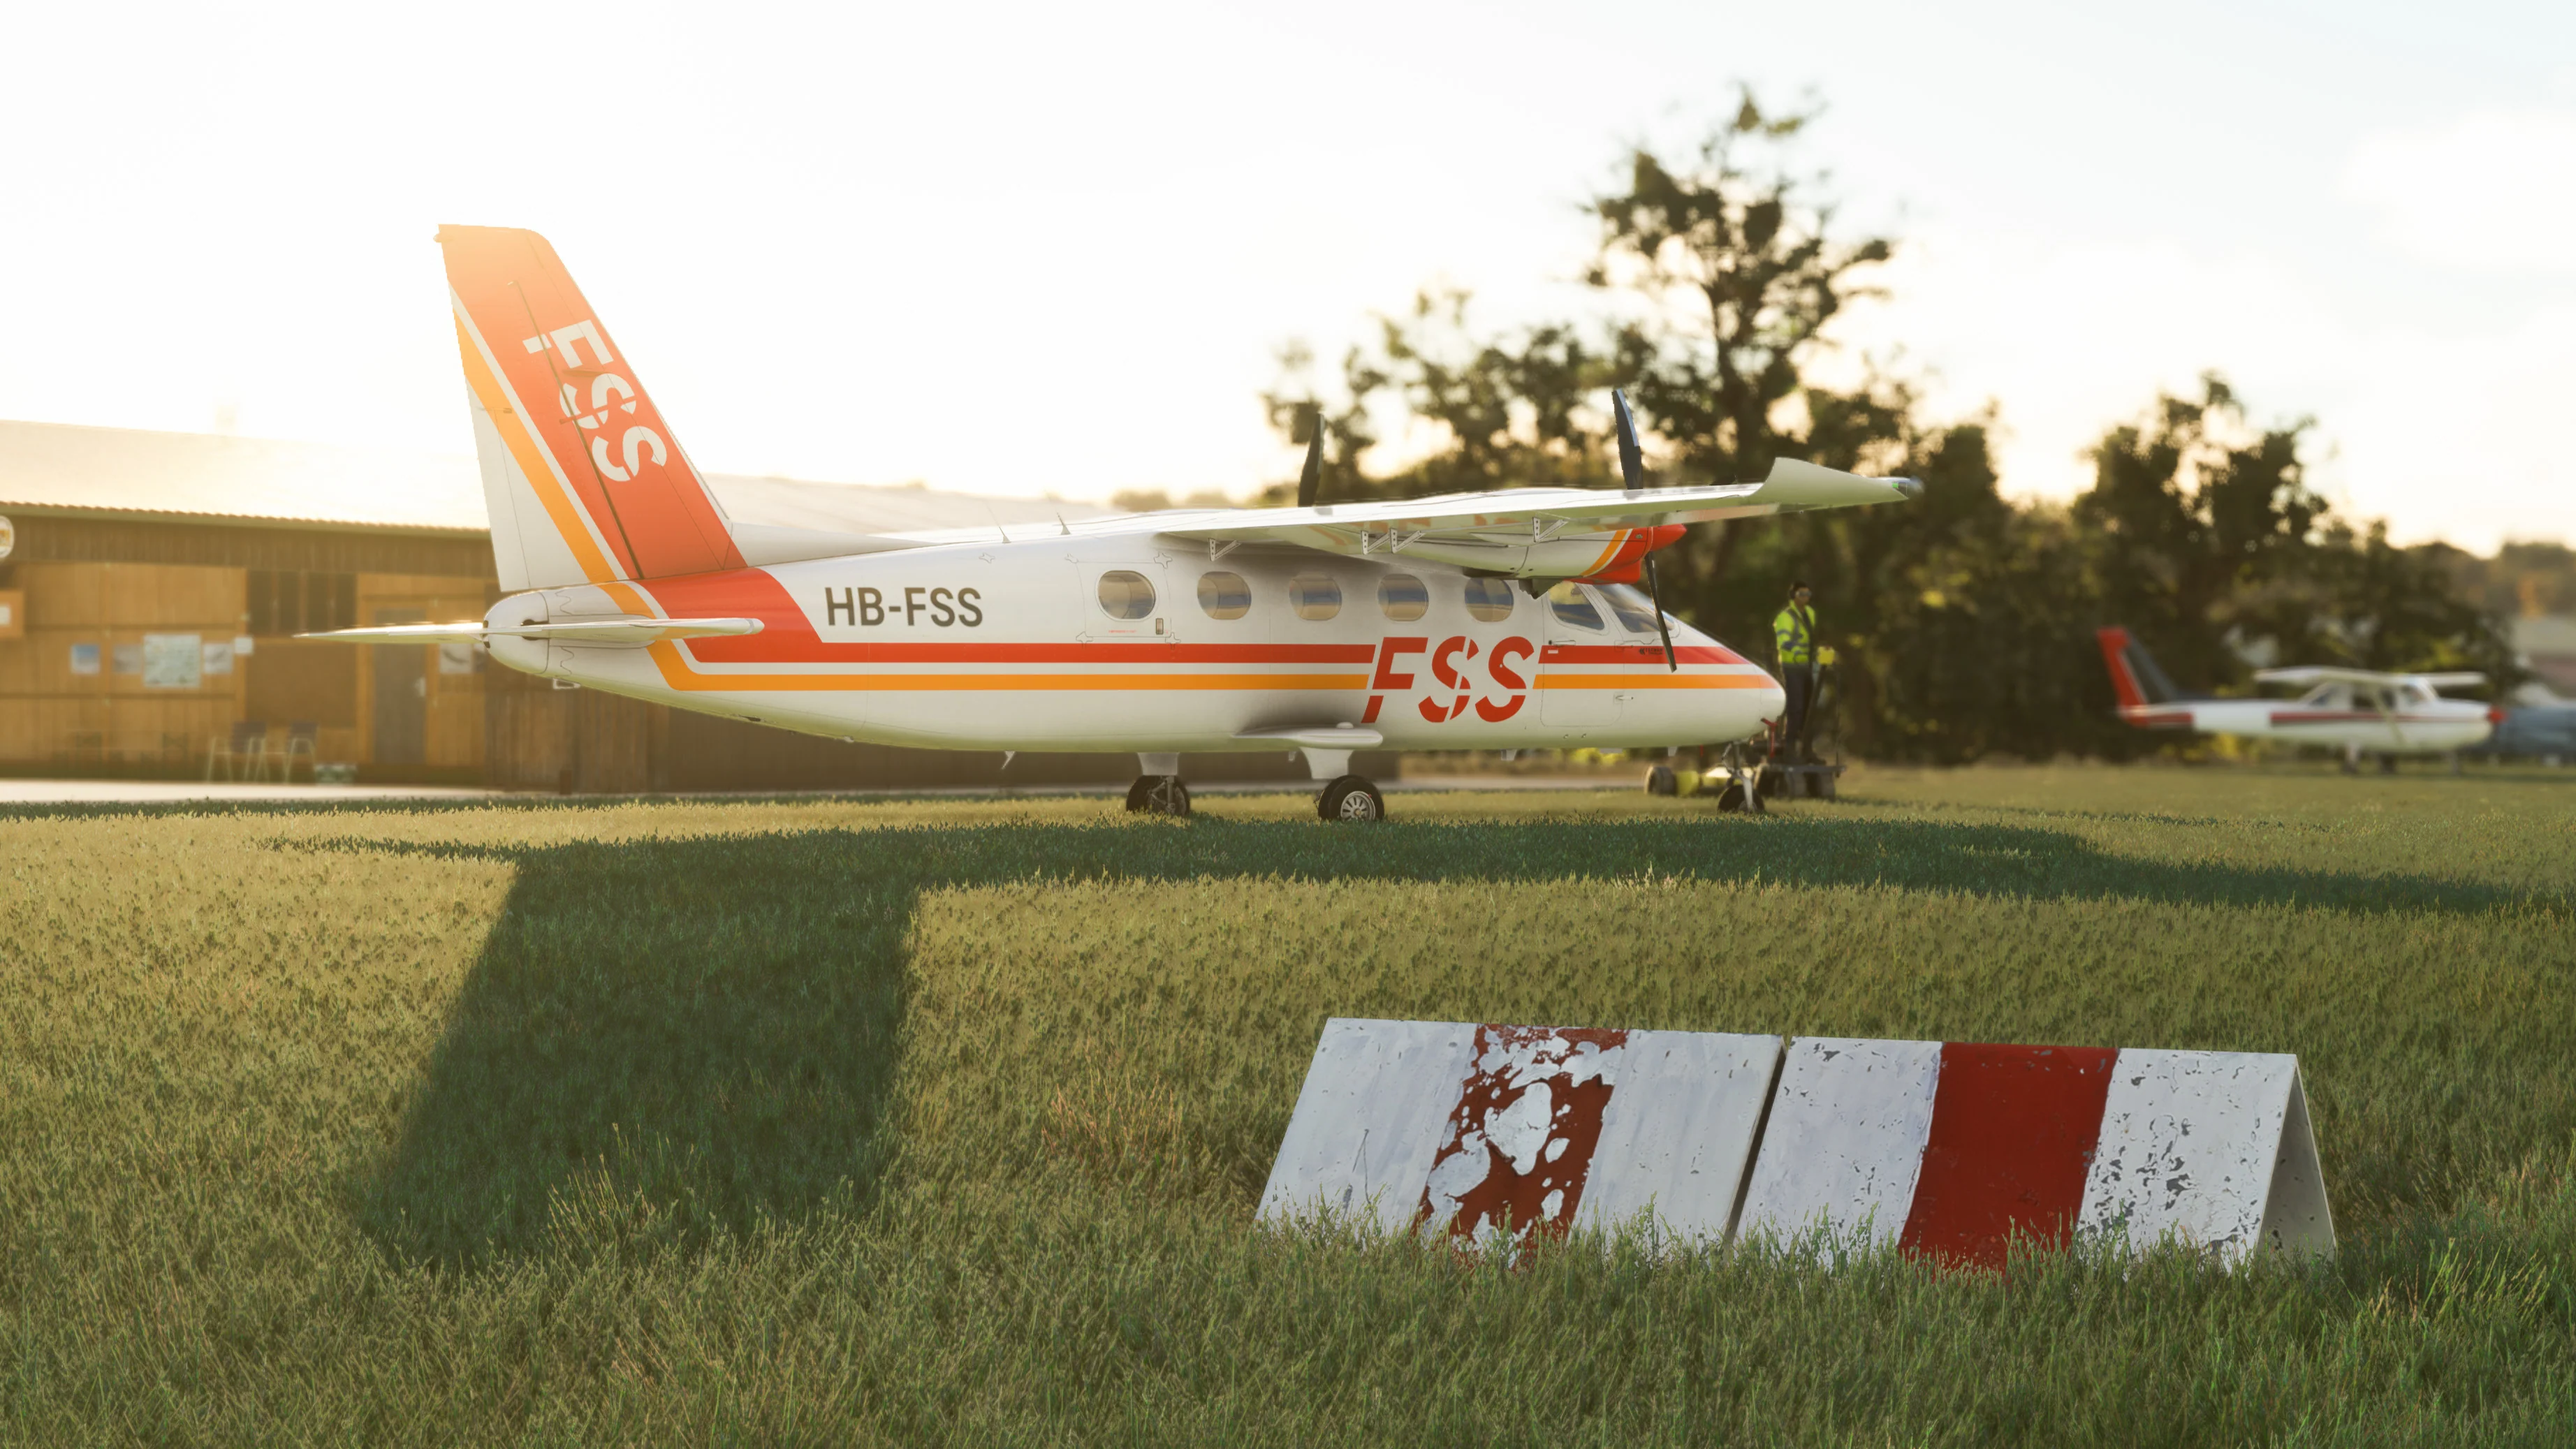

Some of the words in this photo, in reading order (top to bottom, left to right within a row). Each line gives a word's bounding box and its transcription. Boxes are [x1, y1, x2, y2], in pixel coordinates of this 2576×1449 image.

[522, 319, 667, 482] FSS
[825, 587, 983, 627] HB-FSS
[1361, 635, 1535, 723] FSS
